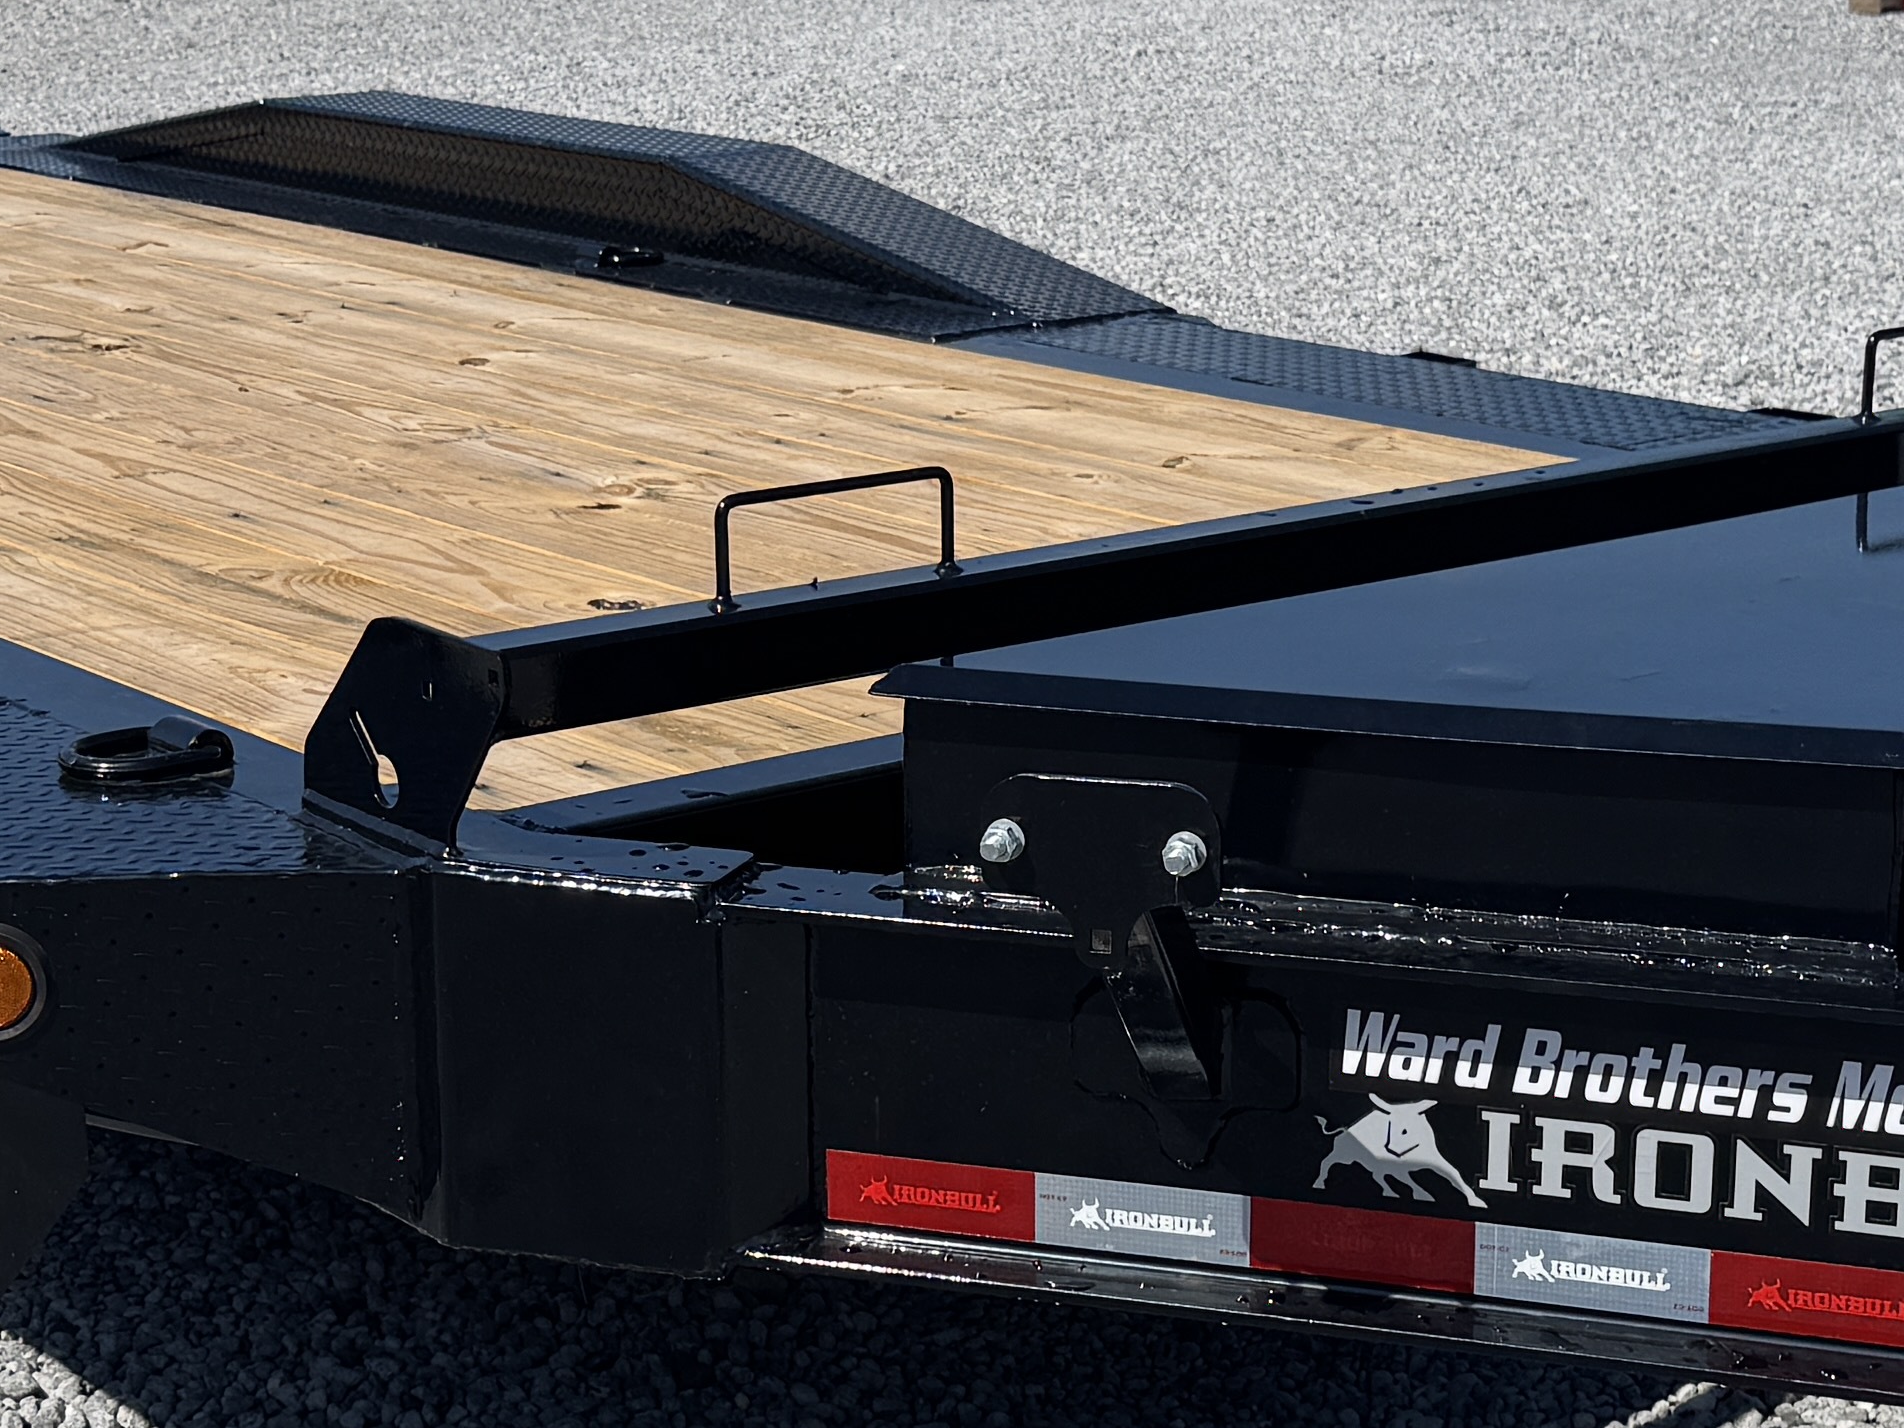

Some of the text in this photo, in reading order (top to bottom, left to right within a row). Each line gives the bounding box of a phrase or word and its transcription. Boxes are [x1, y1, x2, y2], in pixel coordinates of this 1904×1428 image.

[1342, 1008, 1502, 1089] Ward
[1511, 1027, 1813, 1124] Brothers
[893, 1184, 1002, 1214] IRONBULL
[1104, 1208, 1216, 1238] IRONBULL
[1550, 1260, 1671, 1292] IRONBULL
